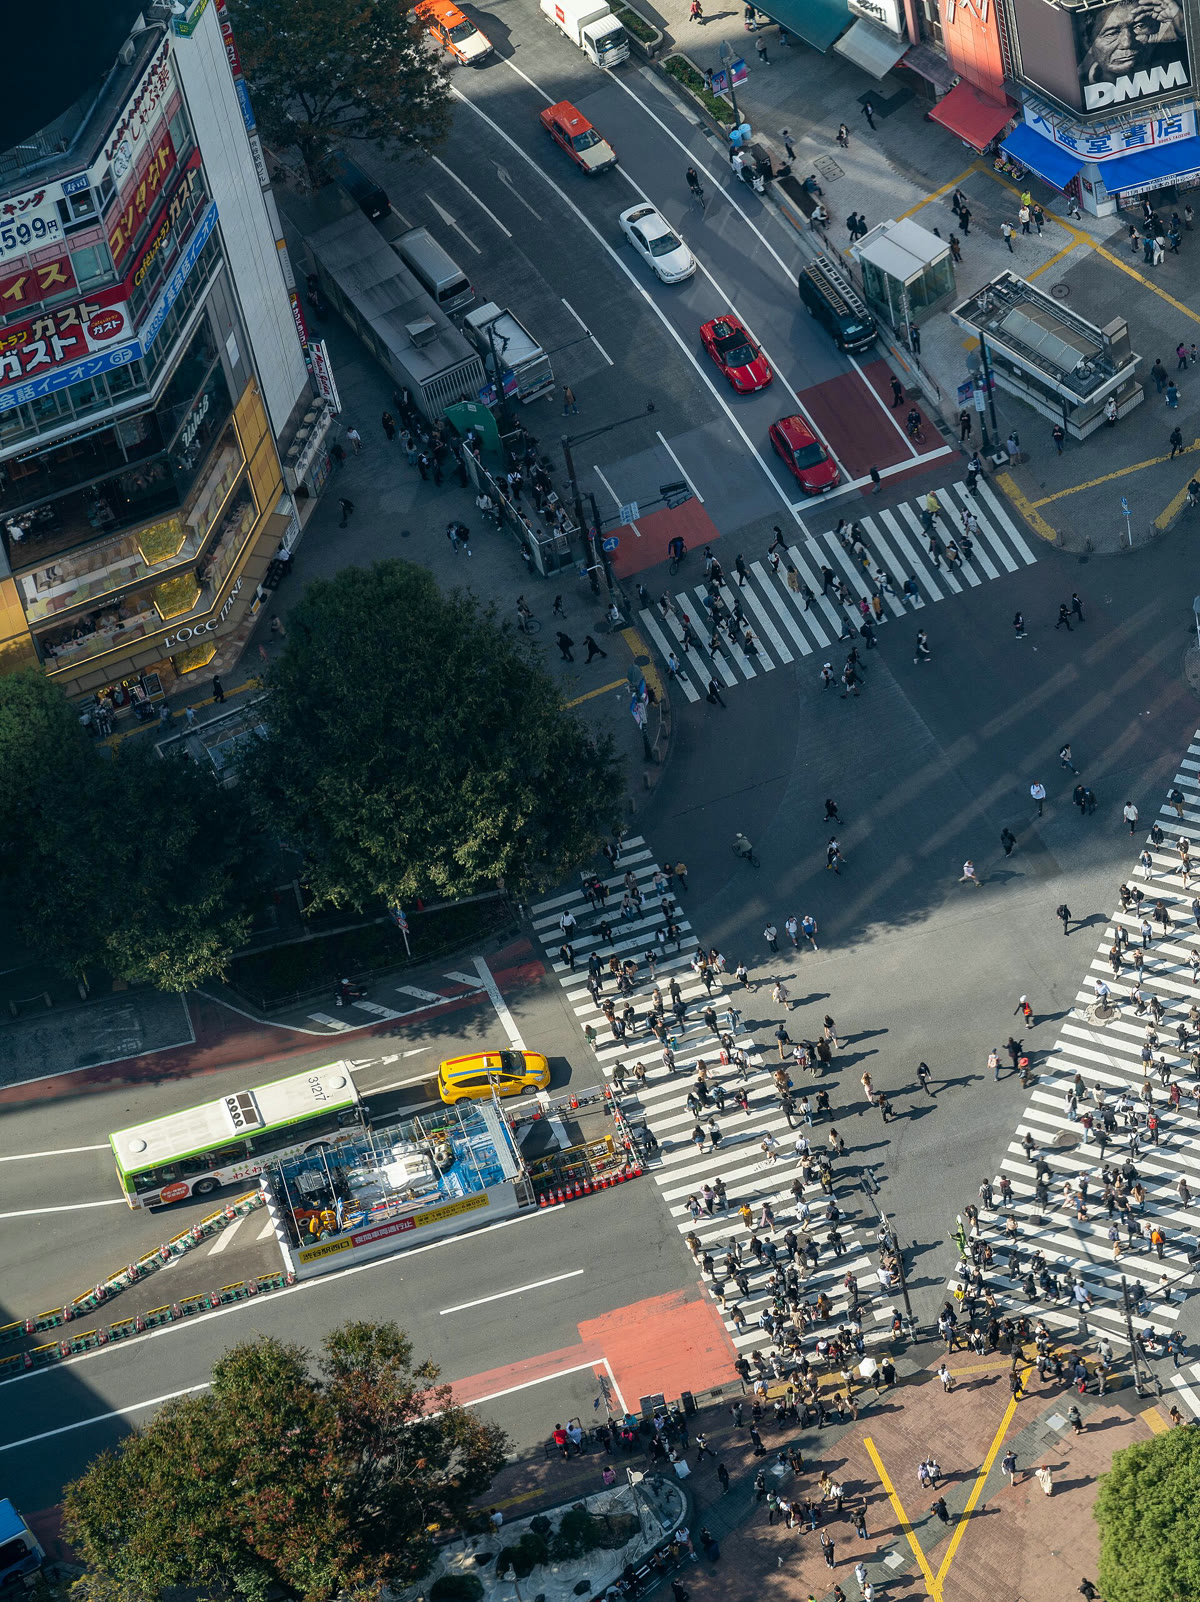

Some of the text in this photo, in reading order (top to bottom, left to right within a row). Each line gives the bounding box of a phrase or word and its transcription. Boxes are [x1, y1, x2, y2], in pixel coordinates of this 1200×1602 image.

[1084, 61, 1188, 110] DMM
[64, 179, 89, 195] 寿司
[168, 168, 198, 226] ガスト
[109, 147, 170, 260] コンタクト
[32, 302, 100, 340] ガスト
[92, 319, 121, 336] ガスト
[0, 334, 77, 380] ガスト
[111, 349, 132, 364] 6F
[308, 1076, 327, 1102] 31217
[302, 1239, 351, 1262] 渋谷駅西口
